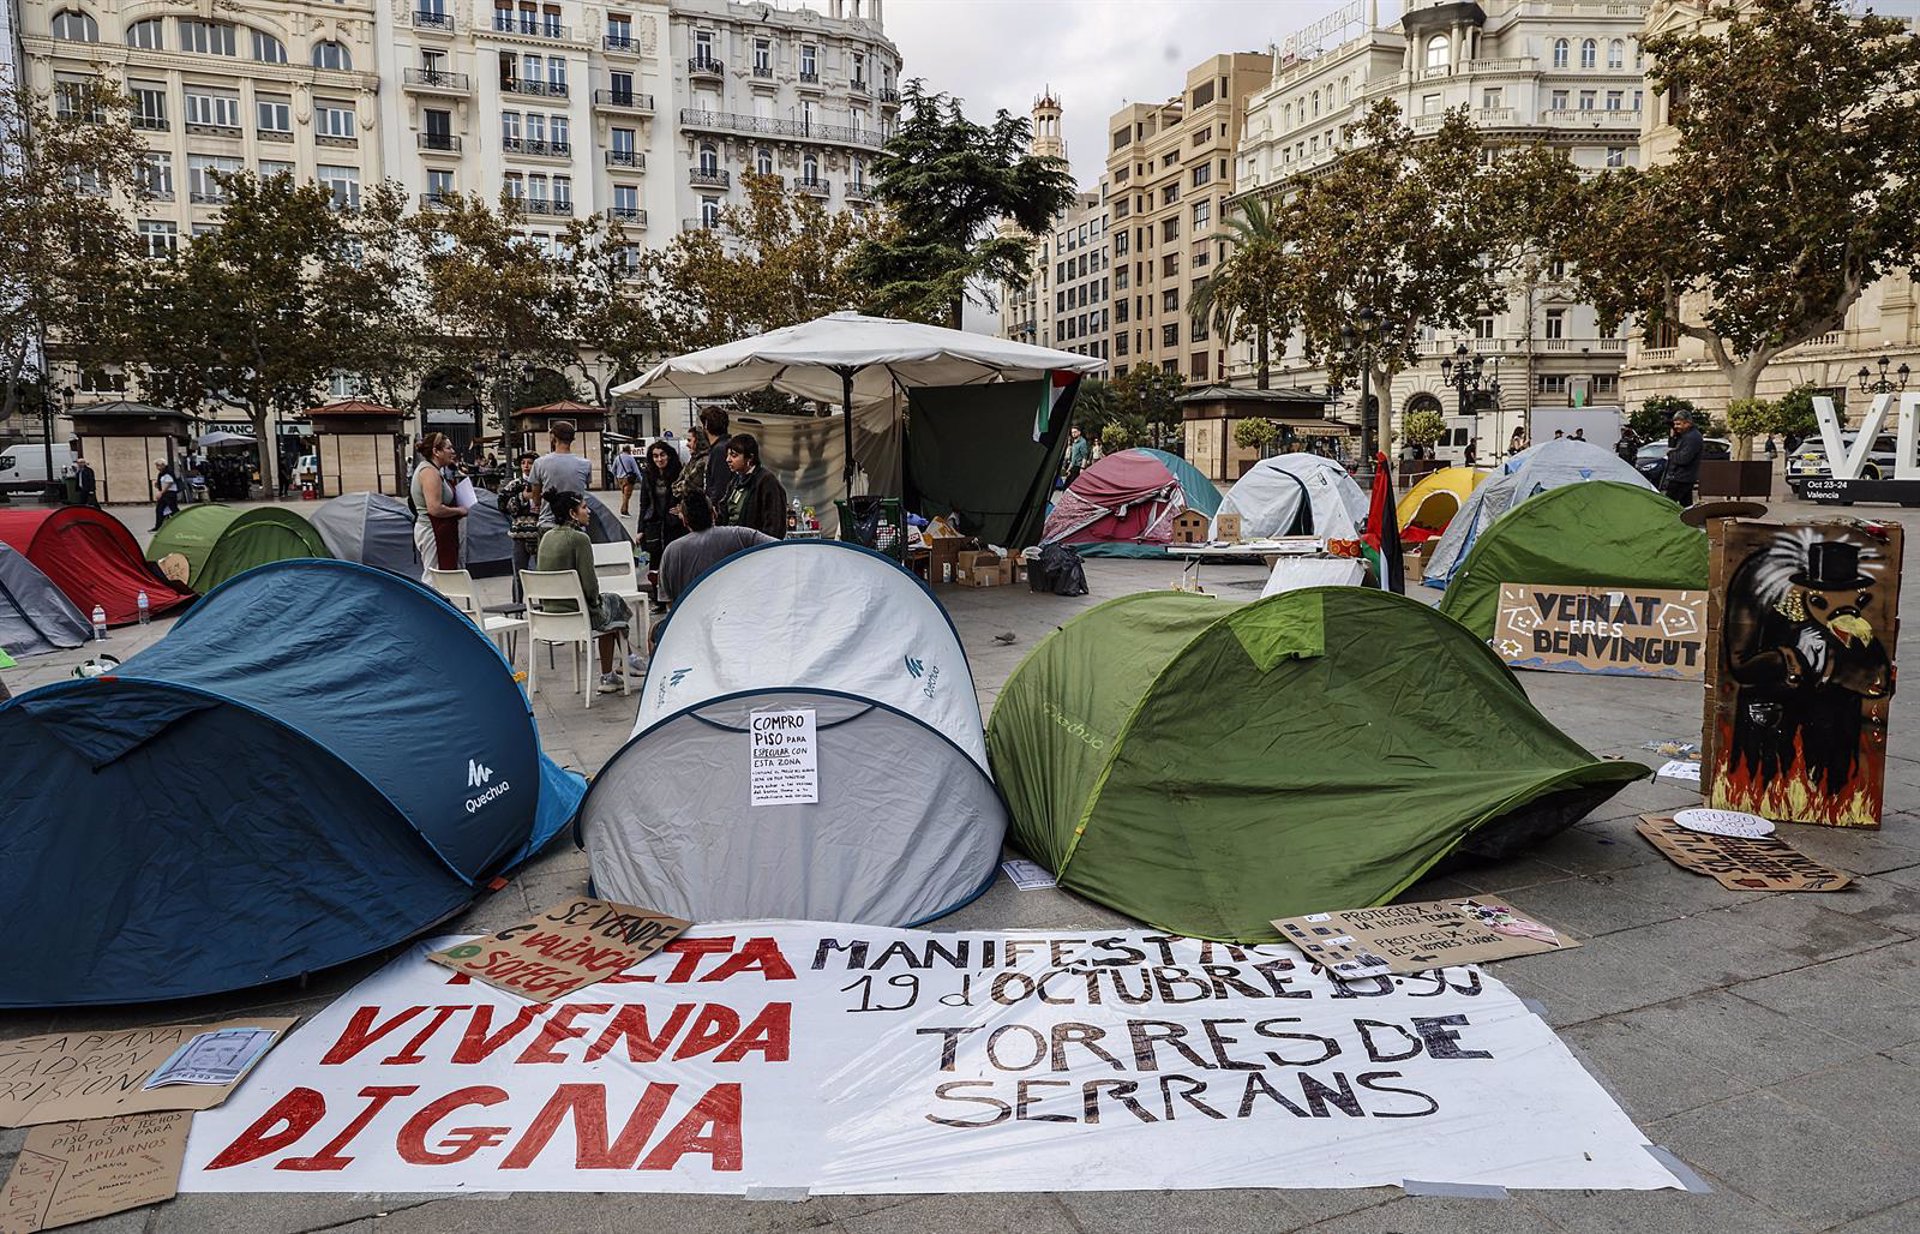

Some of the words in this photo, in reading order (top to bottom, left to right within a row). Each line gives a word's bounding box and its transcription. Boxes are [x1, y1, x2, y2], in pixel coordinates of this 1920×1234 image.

[1807, 481, 1822, 489] Oct
[1824, 481, 1847, 489] 23-24
[1807, 491, 1839, 499] Valencia
[1570, 620, 1624, 637] ERES
[1533, 630, 1700, 667] BENVINGUT
[753, 715, 804, 731] COMPRO
[791, 747, 807, 755] CON
[466, 781, 510, 813] Quechua
[1354, 922, 1375, 931] LA
[1387, 945, 1416, 957] ELS
[840, 974, 919, 1012] 19
[319, 1002, 792, 1066] VIVENDA
[916, 1017, 1345, 1072] TORRES
[1353, 1014, 1495, 1064] DE
[924, 1072, 1440, 1128] SERRANS
[51, 1134, 88, 1149] PISO
[102, 1125, 130, 1136] CON
[138, 1113, 182, 1129] TECHOS
[66, 1137, 113, 1154] ALTOS
[133, 1124, 173, 1139] PARA
[203, 1082, 743, 1171] DIGNA
[83, 1138, 166, 1164] APILARNOS
